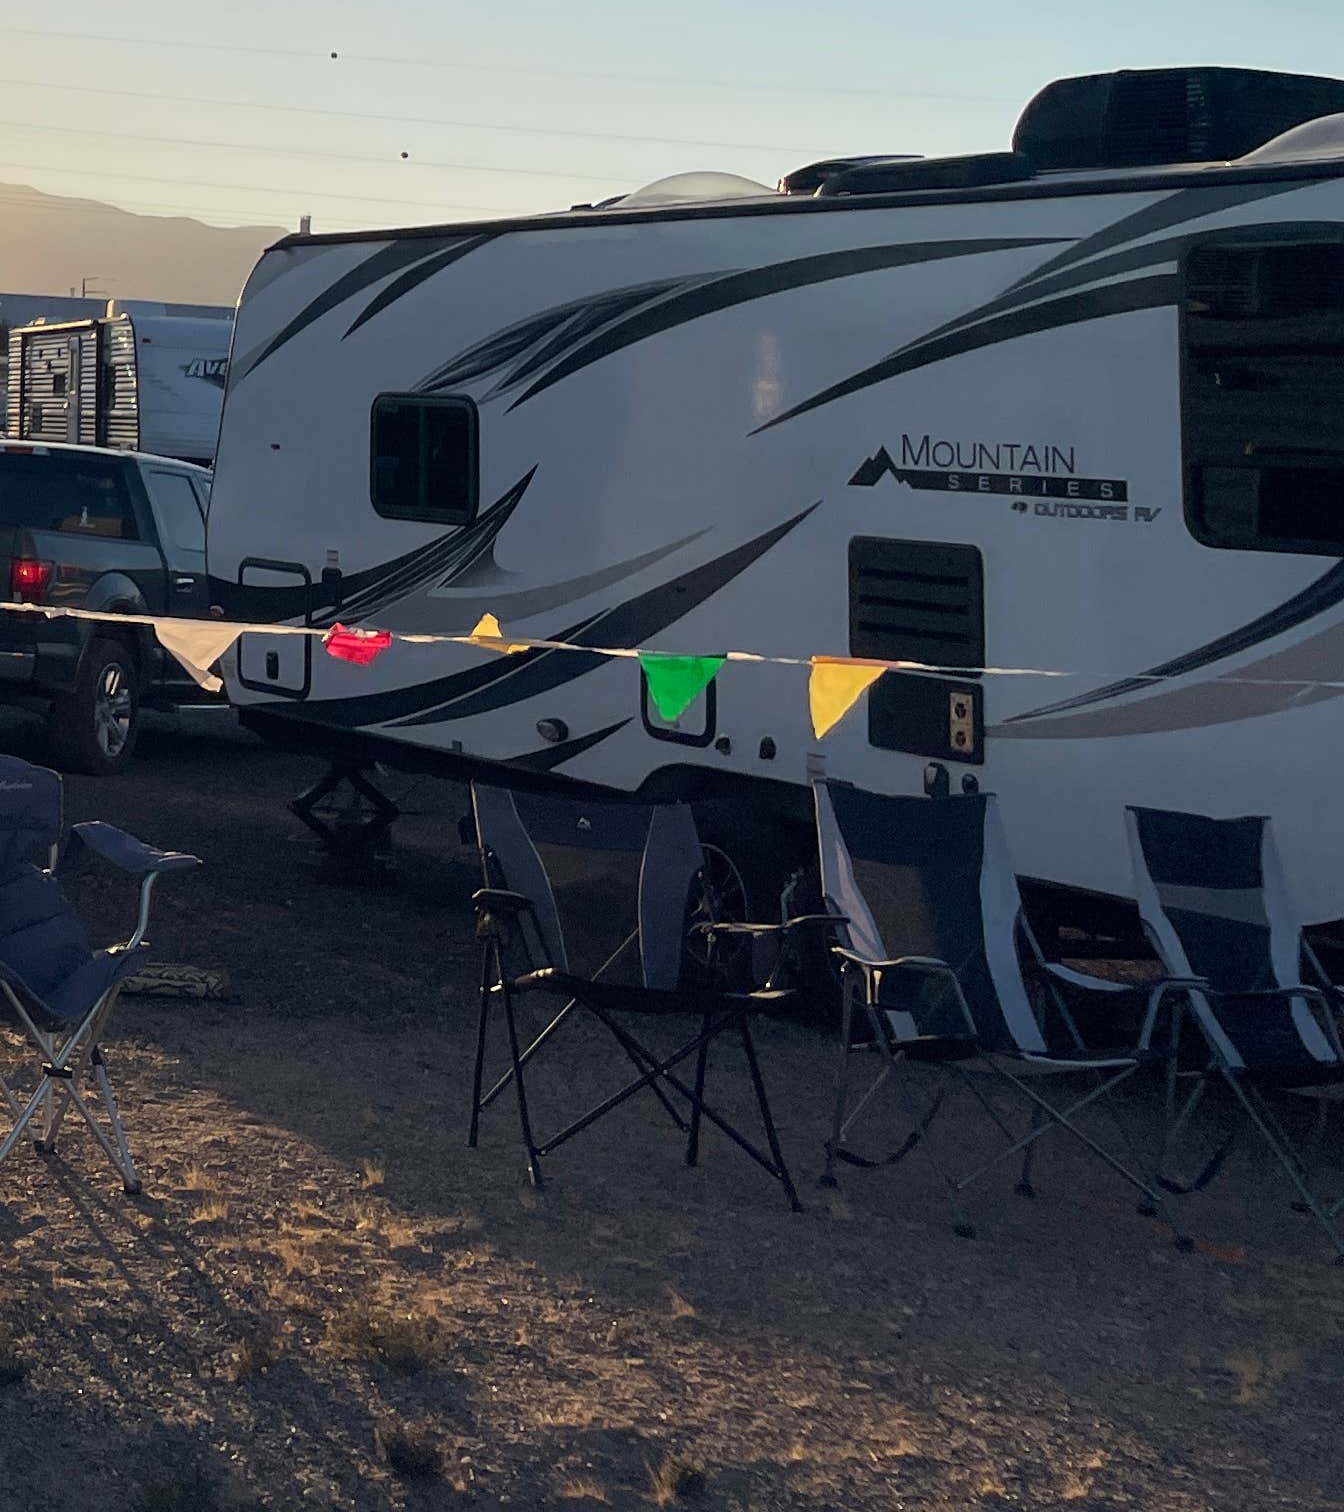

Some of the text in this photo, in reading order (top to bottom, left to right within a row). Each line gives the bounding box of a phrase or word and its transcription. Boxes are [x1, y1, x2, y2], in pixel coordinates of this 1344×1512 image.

[948, 476, 1114, 498] SERIES
[1034, 503, 1162, 522] OUTDOORS RV
